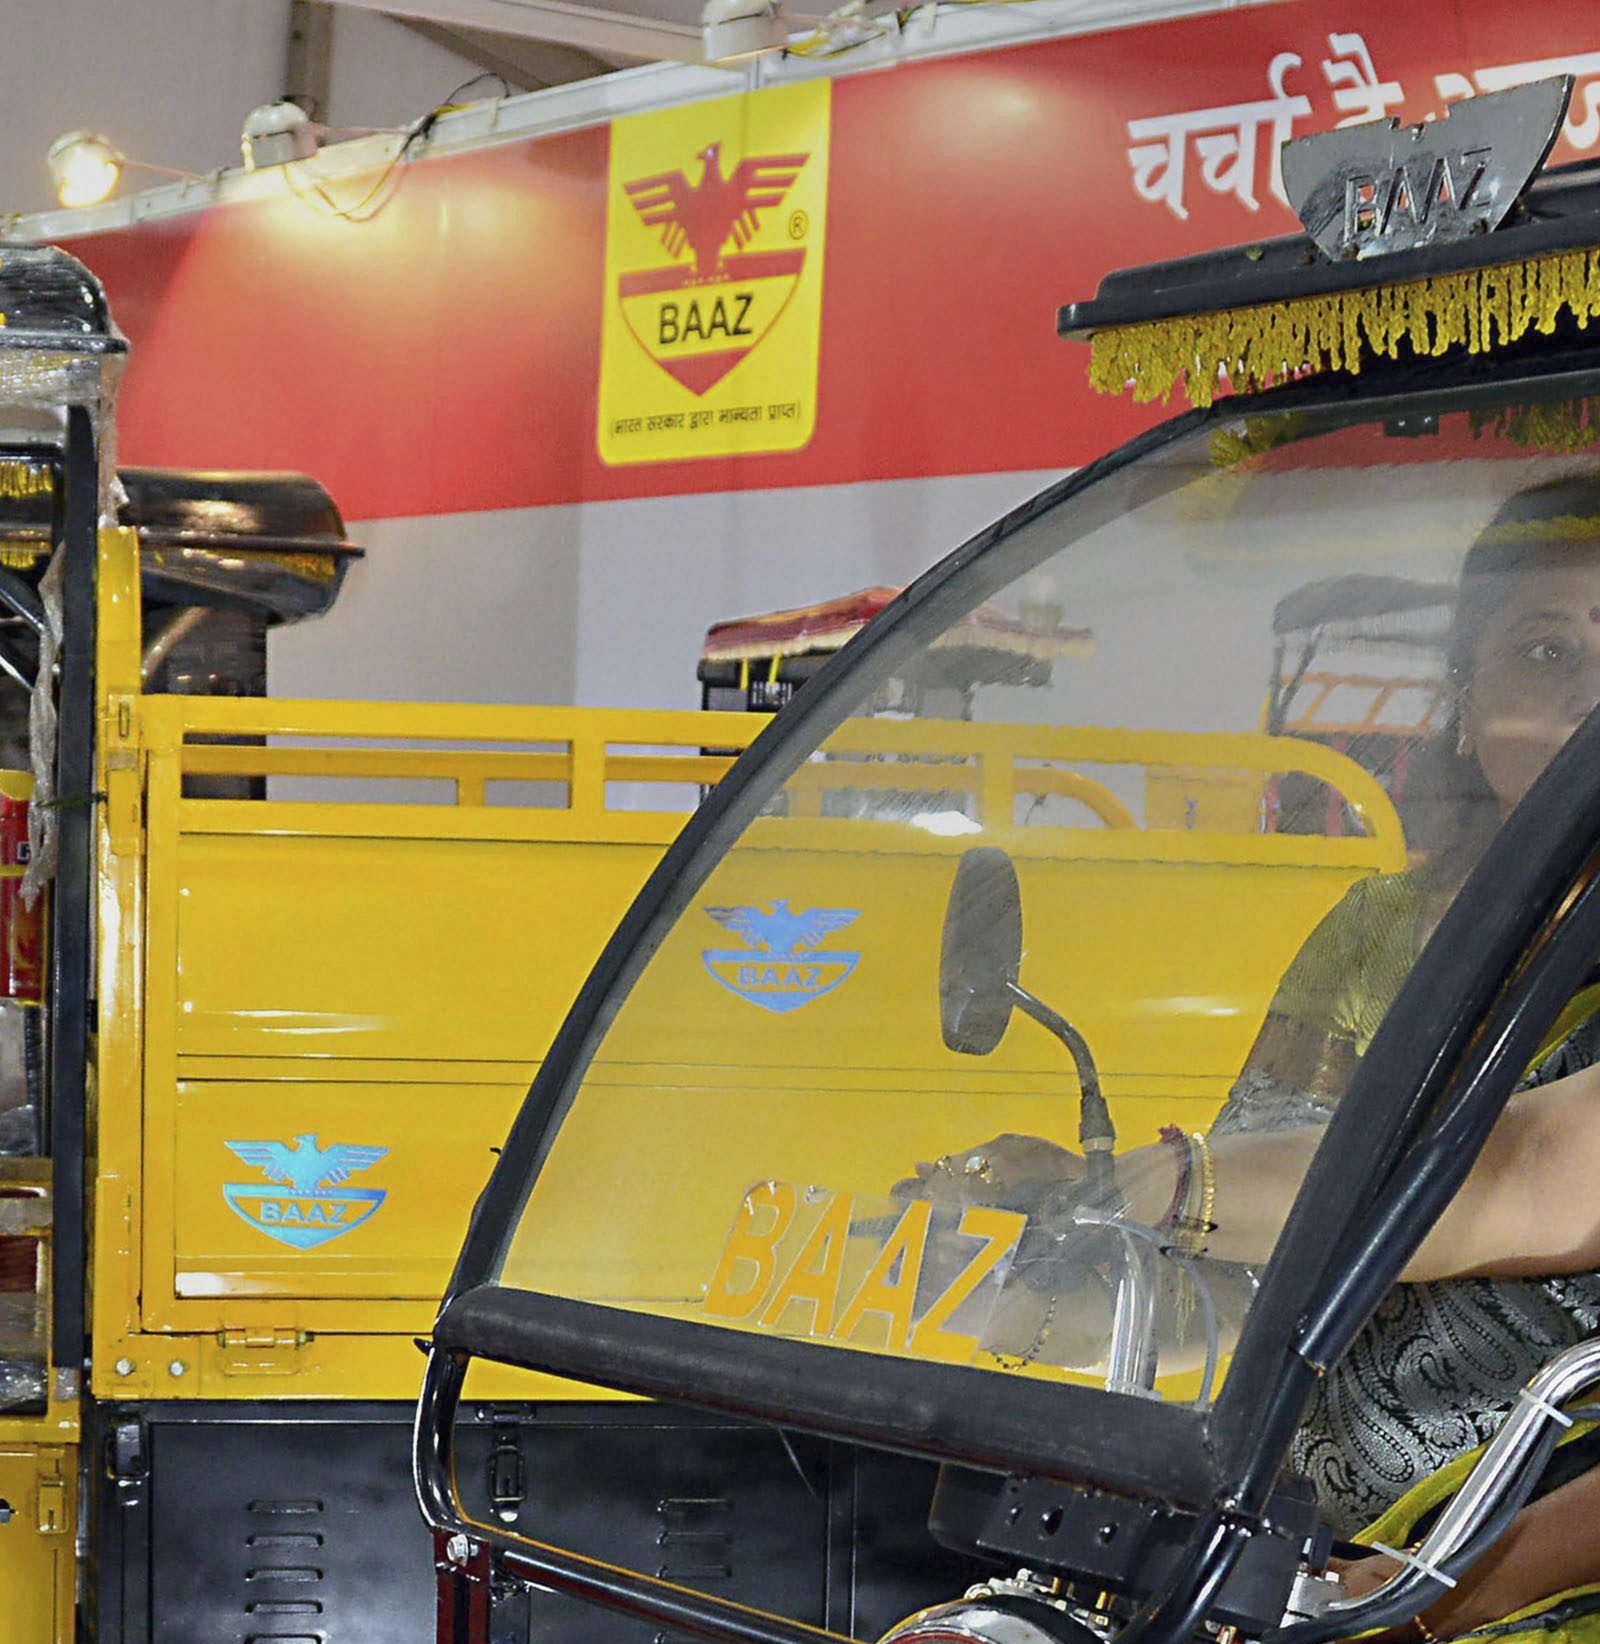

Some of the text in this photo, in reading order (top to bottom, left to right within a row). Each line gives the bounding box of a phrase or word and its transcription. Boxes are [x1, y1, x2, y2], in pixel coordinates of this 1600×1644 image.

[1344, 147, 1496, 246] BAAZ
[658, 293, 754, 345] BAAZ
[736, 966, 822, 989] BAAZ
[259, 1201, 348, 1227] BAAZ
[701, 1180, 1028, 1364] BAAZ
